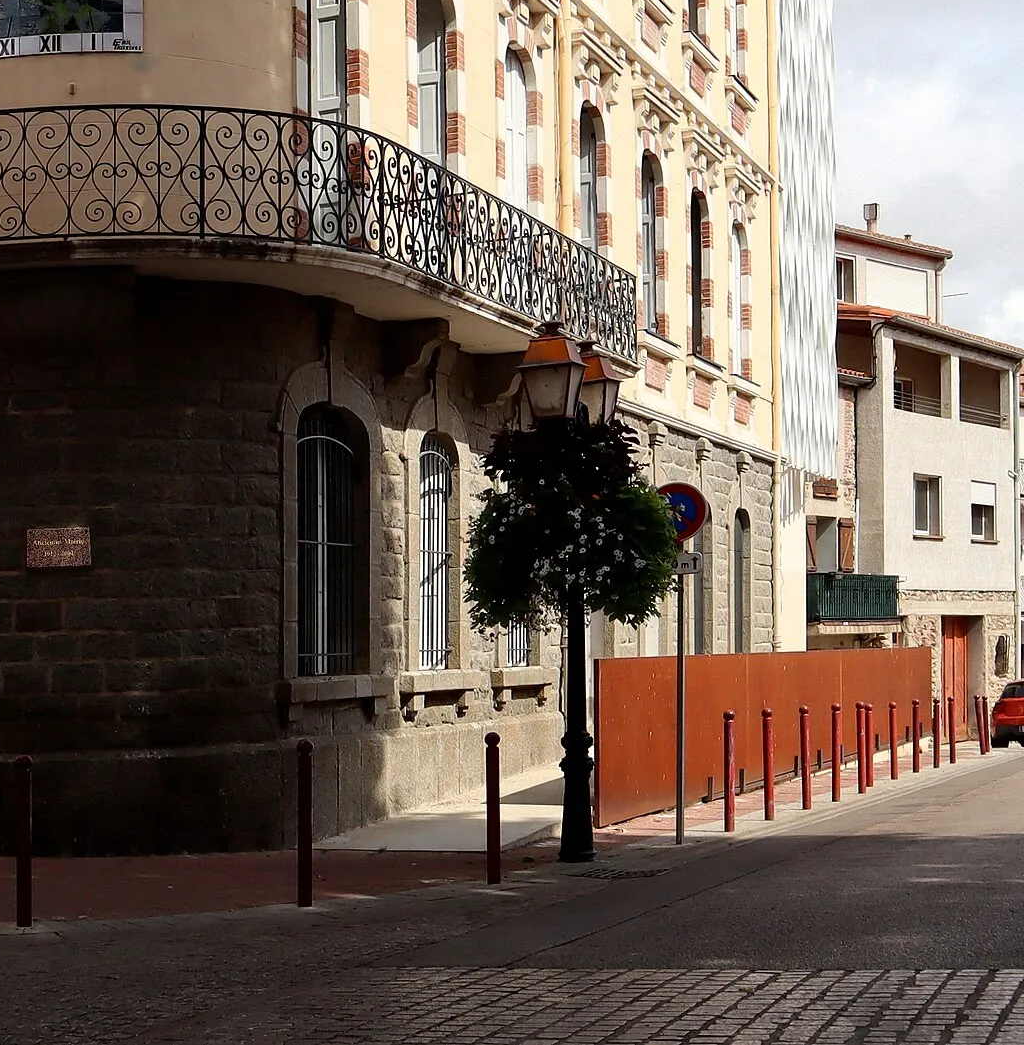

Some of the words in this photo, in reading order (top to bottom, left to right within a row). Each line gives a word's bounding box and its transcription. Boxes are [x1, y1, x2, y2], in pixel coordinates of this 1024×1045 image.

[0, 38, 16, 57] XI
[39, 34, 61, 53] XII
[91, 33, 96, 51] I
